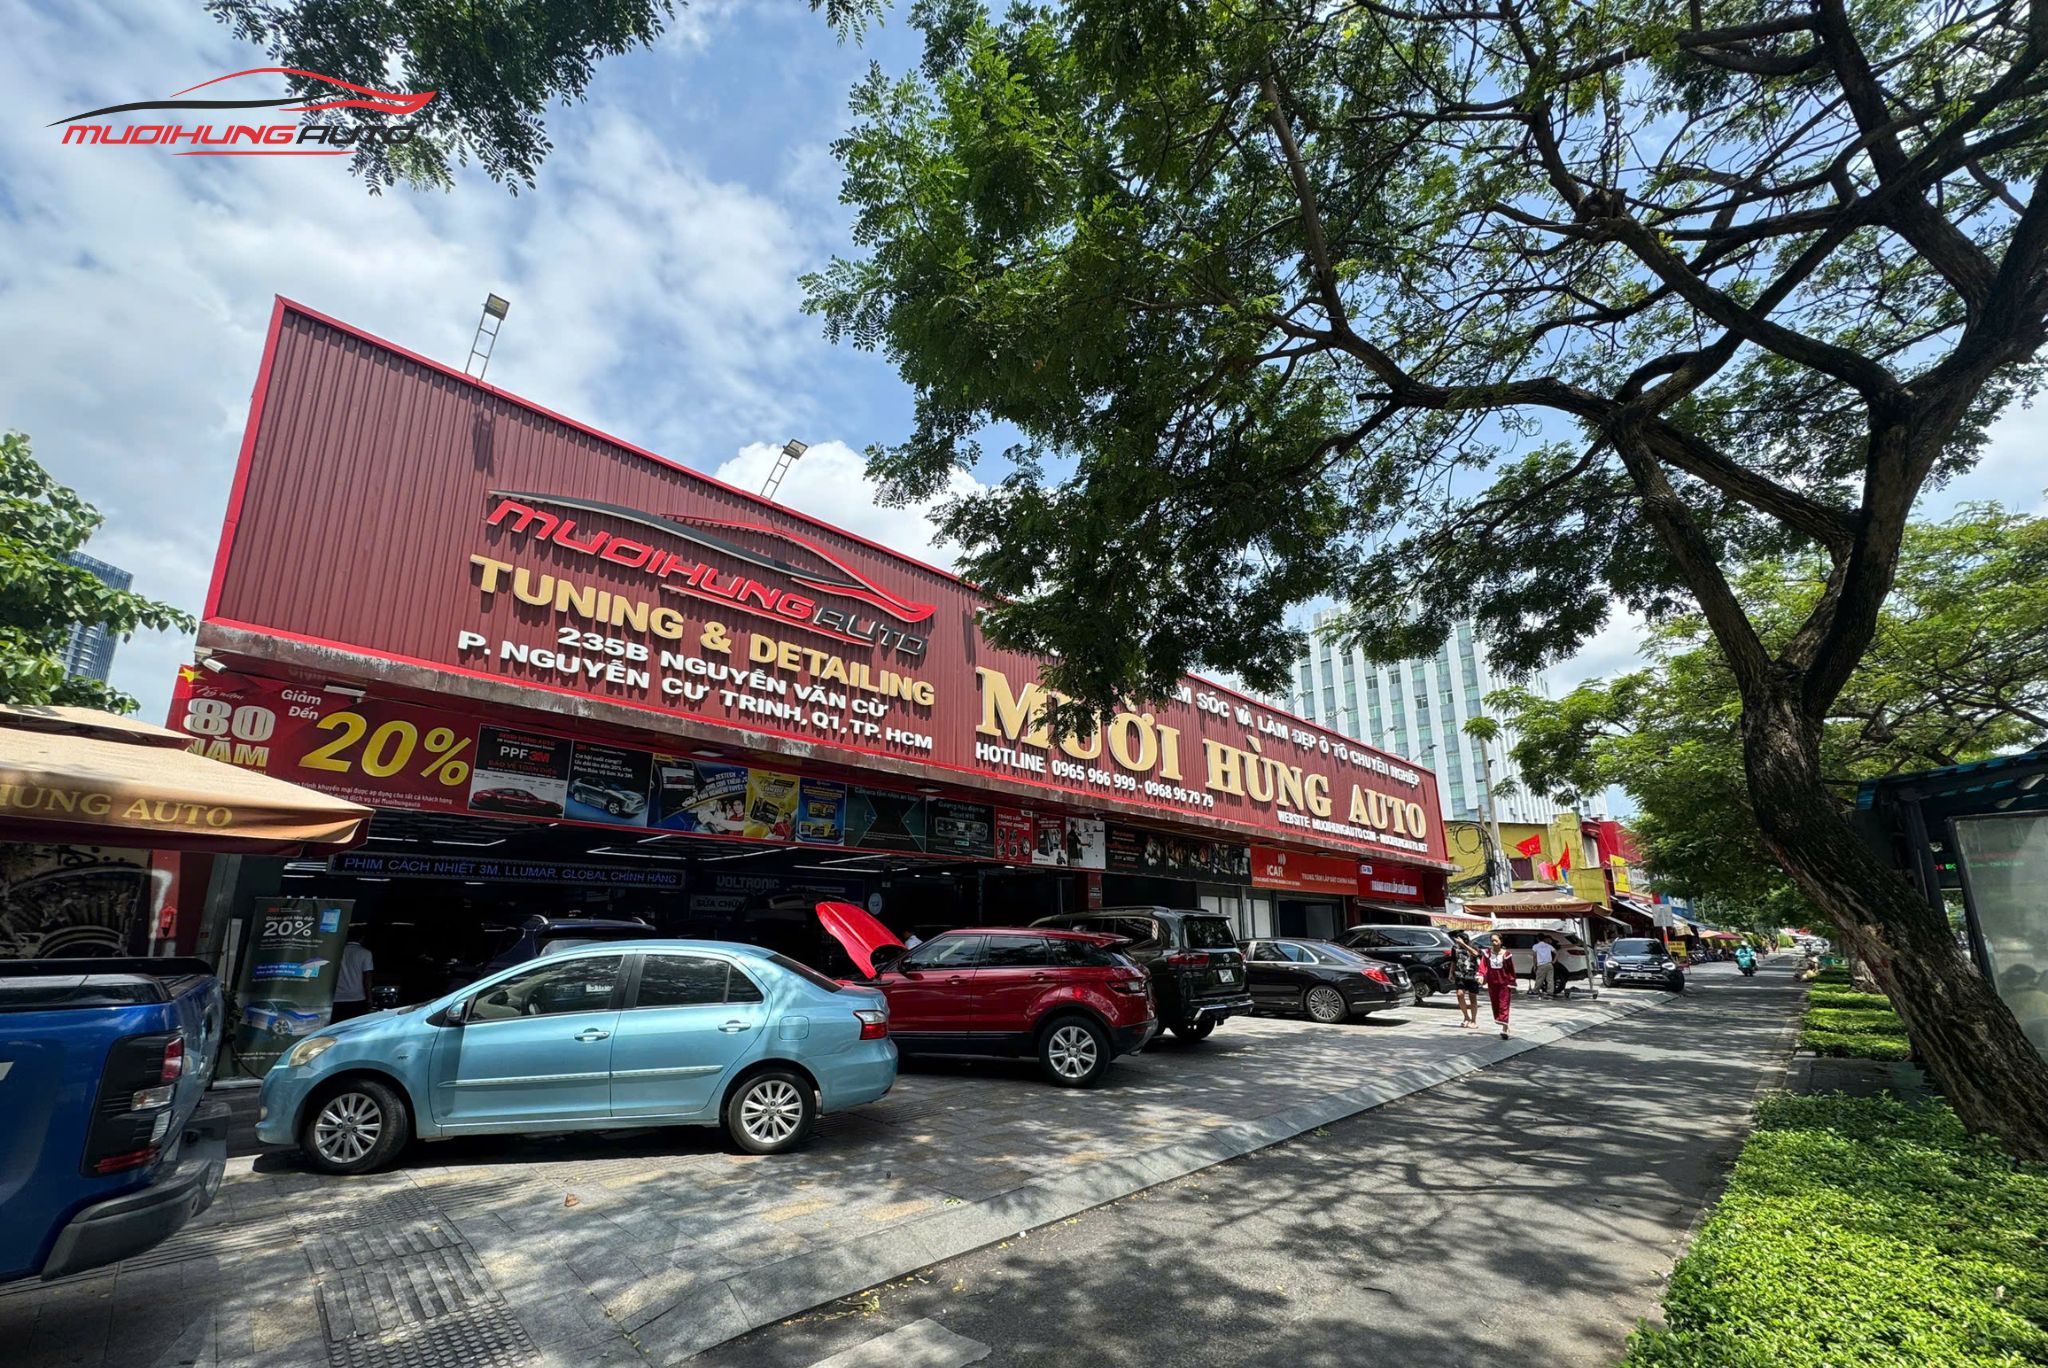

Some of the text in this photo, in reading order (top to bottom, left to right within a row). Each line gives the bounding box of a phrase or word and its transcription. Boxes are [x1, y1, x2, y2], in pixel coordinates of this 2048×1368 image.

[469, 553, 935, 706] TUNING & DETAILING
[557, 626, 889, 718] 235B NGUYỄN VĂN CỪ
[281, 689, 322, 707] Giảm
[457, 630, 491, 656] P.
[500, 640, 650, 689] NGUYỄN
[720, 689, 808, 726] TRINH,
[886, 727, 933, 750] HCM
[183, 697, 276, 742] 80
[288, 705, 319, 721] Đến
[298, 711, 472, 787] 20%
[500, 745, 529, 760] PPF
[1195, 691, 1231, 718] SÓC
[1233, 704, 1255, 728] VÀ
[1257, 714, 1289, 740] LÀM
[1291, 728, 1317, 751] ĐẸP
[1318, 735, 1330, 754] Ô
[1330, 743, 1349, 761] TÔ
[1349, 750, 1390, 776] CHUYÊN
[1389, 765, 1420, 789] NGHIỆP
[1051, 759, 1085, 781] 0965
[1087, 768, 1111, 787] 966
[1113, 773, 1137, 792] 999
[1144, 780, 1172, 799] 0968
[1202, 734, 1332, 817] HÙNG
[1348, 784, 1427, 839] AUTO
[121, 797, 233, 828] AUTO
[344, 857, 383, 870] PHIM
[562, 869, 607, 881] GLOBAL
[716, 874, 780, 889] VOLTRONIC
[1266, 865, 1284, 877] ICAR
[262, 920, 314, 937] 20%
